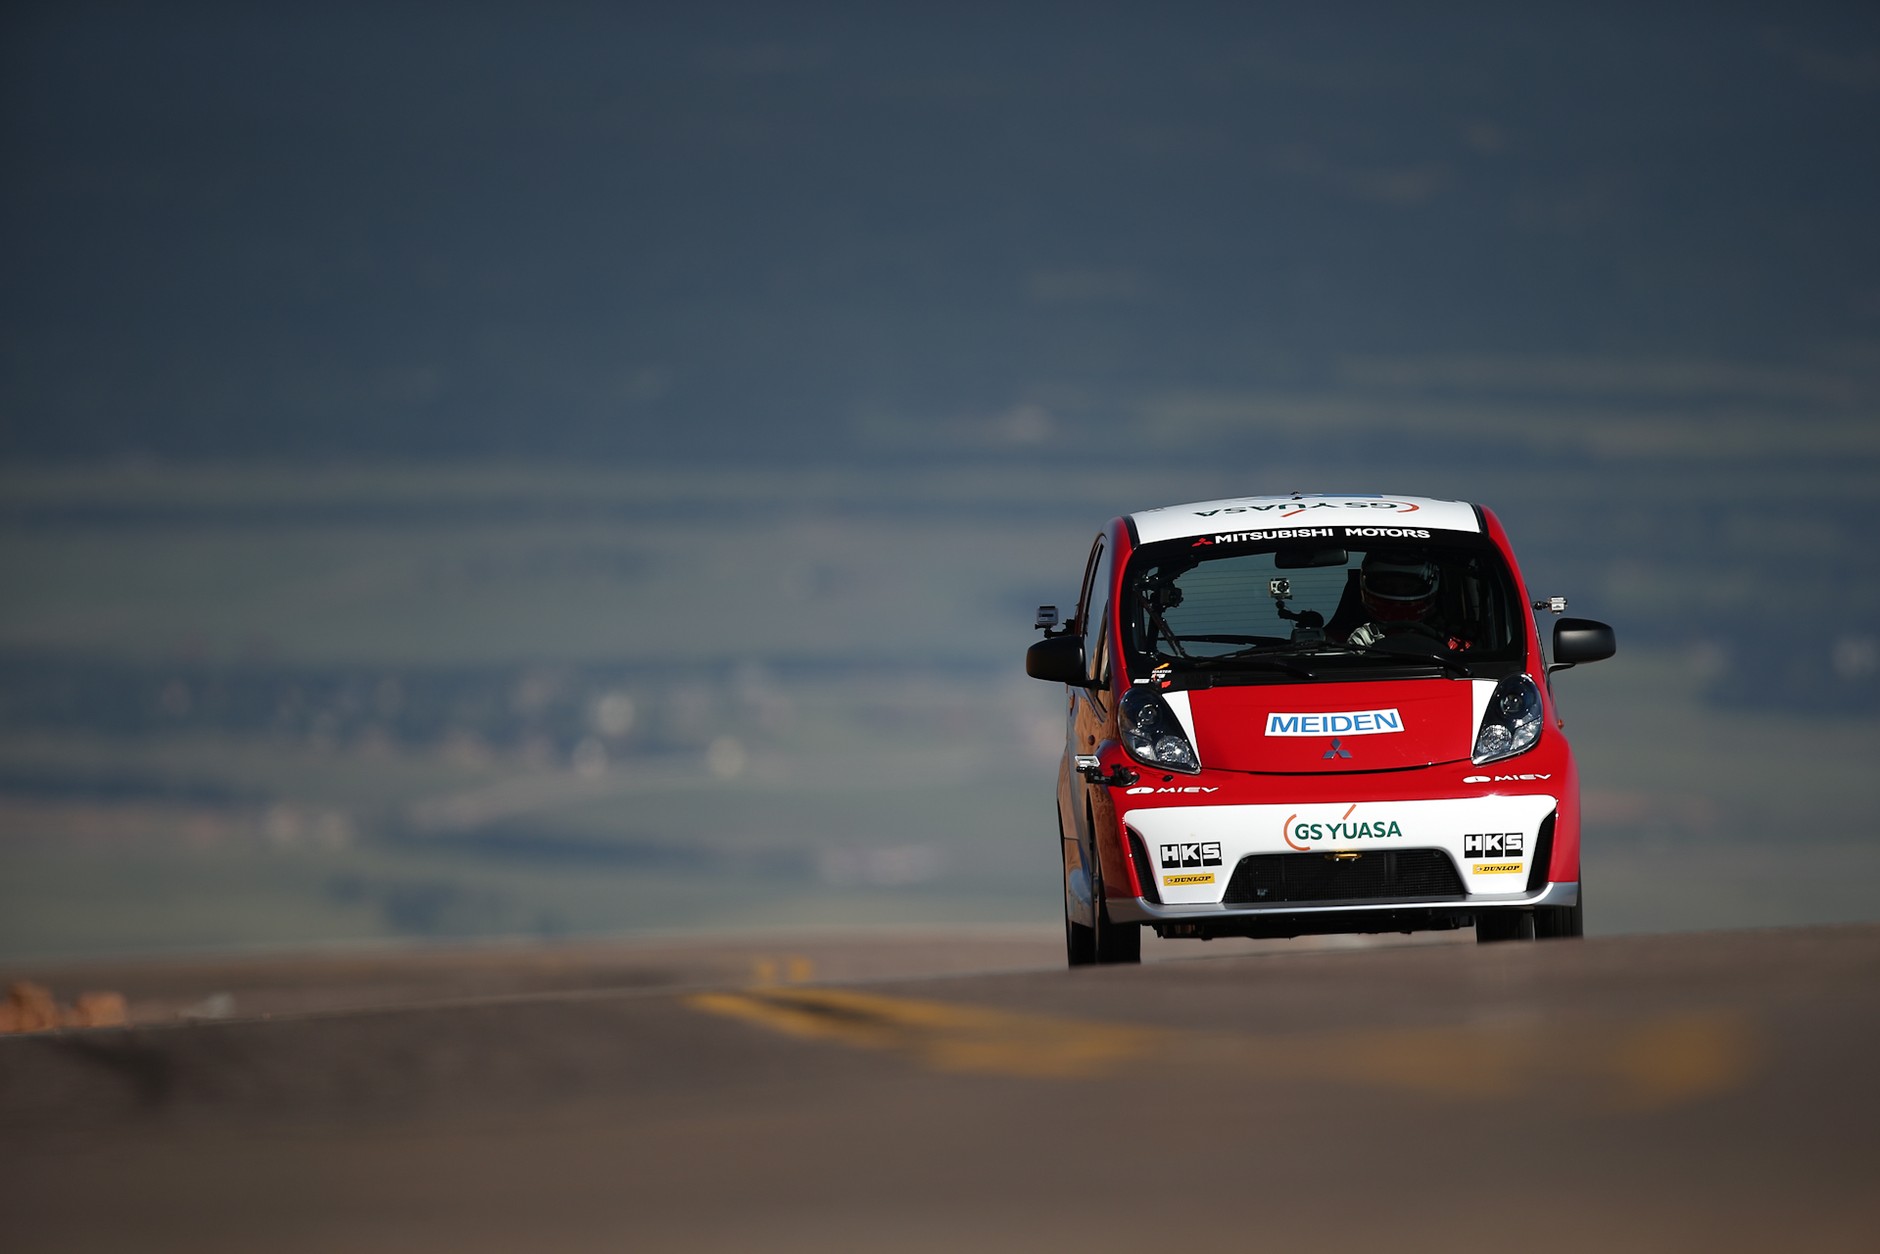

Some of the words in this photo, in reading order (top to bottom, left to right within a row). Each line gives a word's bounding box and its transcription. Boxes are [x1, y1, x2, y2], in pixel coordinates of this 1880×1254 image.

[1215, 529, 1333, 544] MITSUBISHI
[1345, 528, 1431, 539] MOTORS
[1271, 712, 1398, 733] MEIDEN
[1295, 823, 1323, 840] GS
[1325, 821, 1402, 840] YUASA
[1465, 834, 1522, 851] HKS
[1161, 843, 1221, 861] HKS
